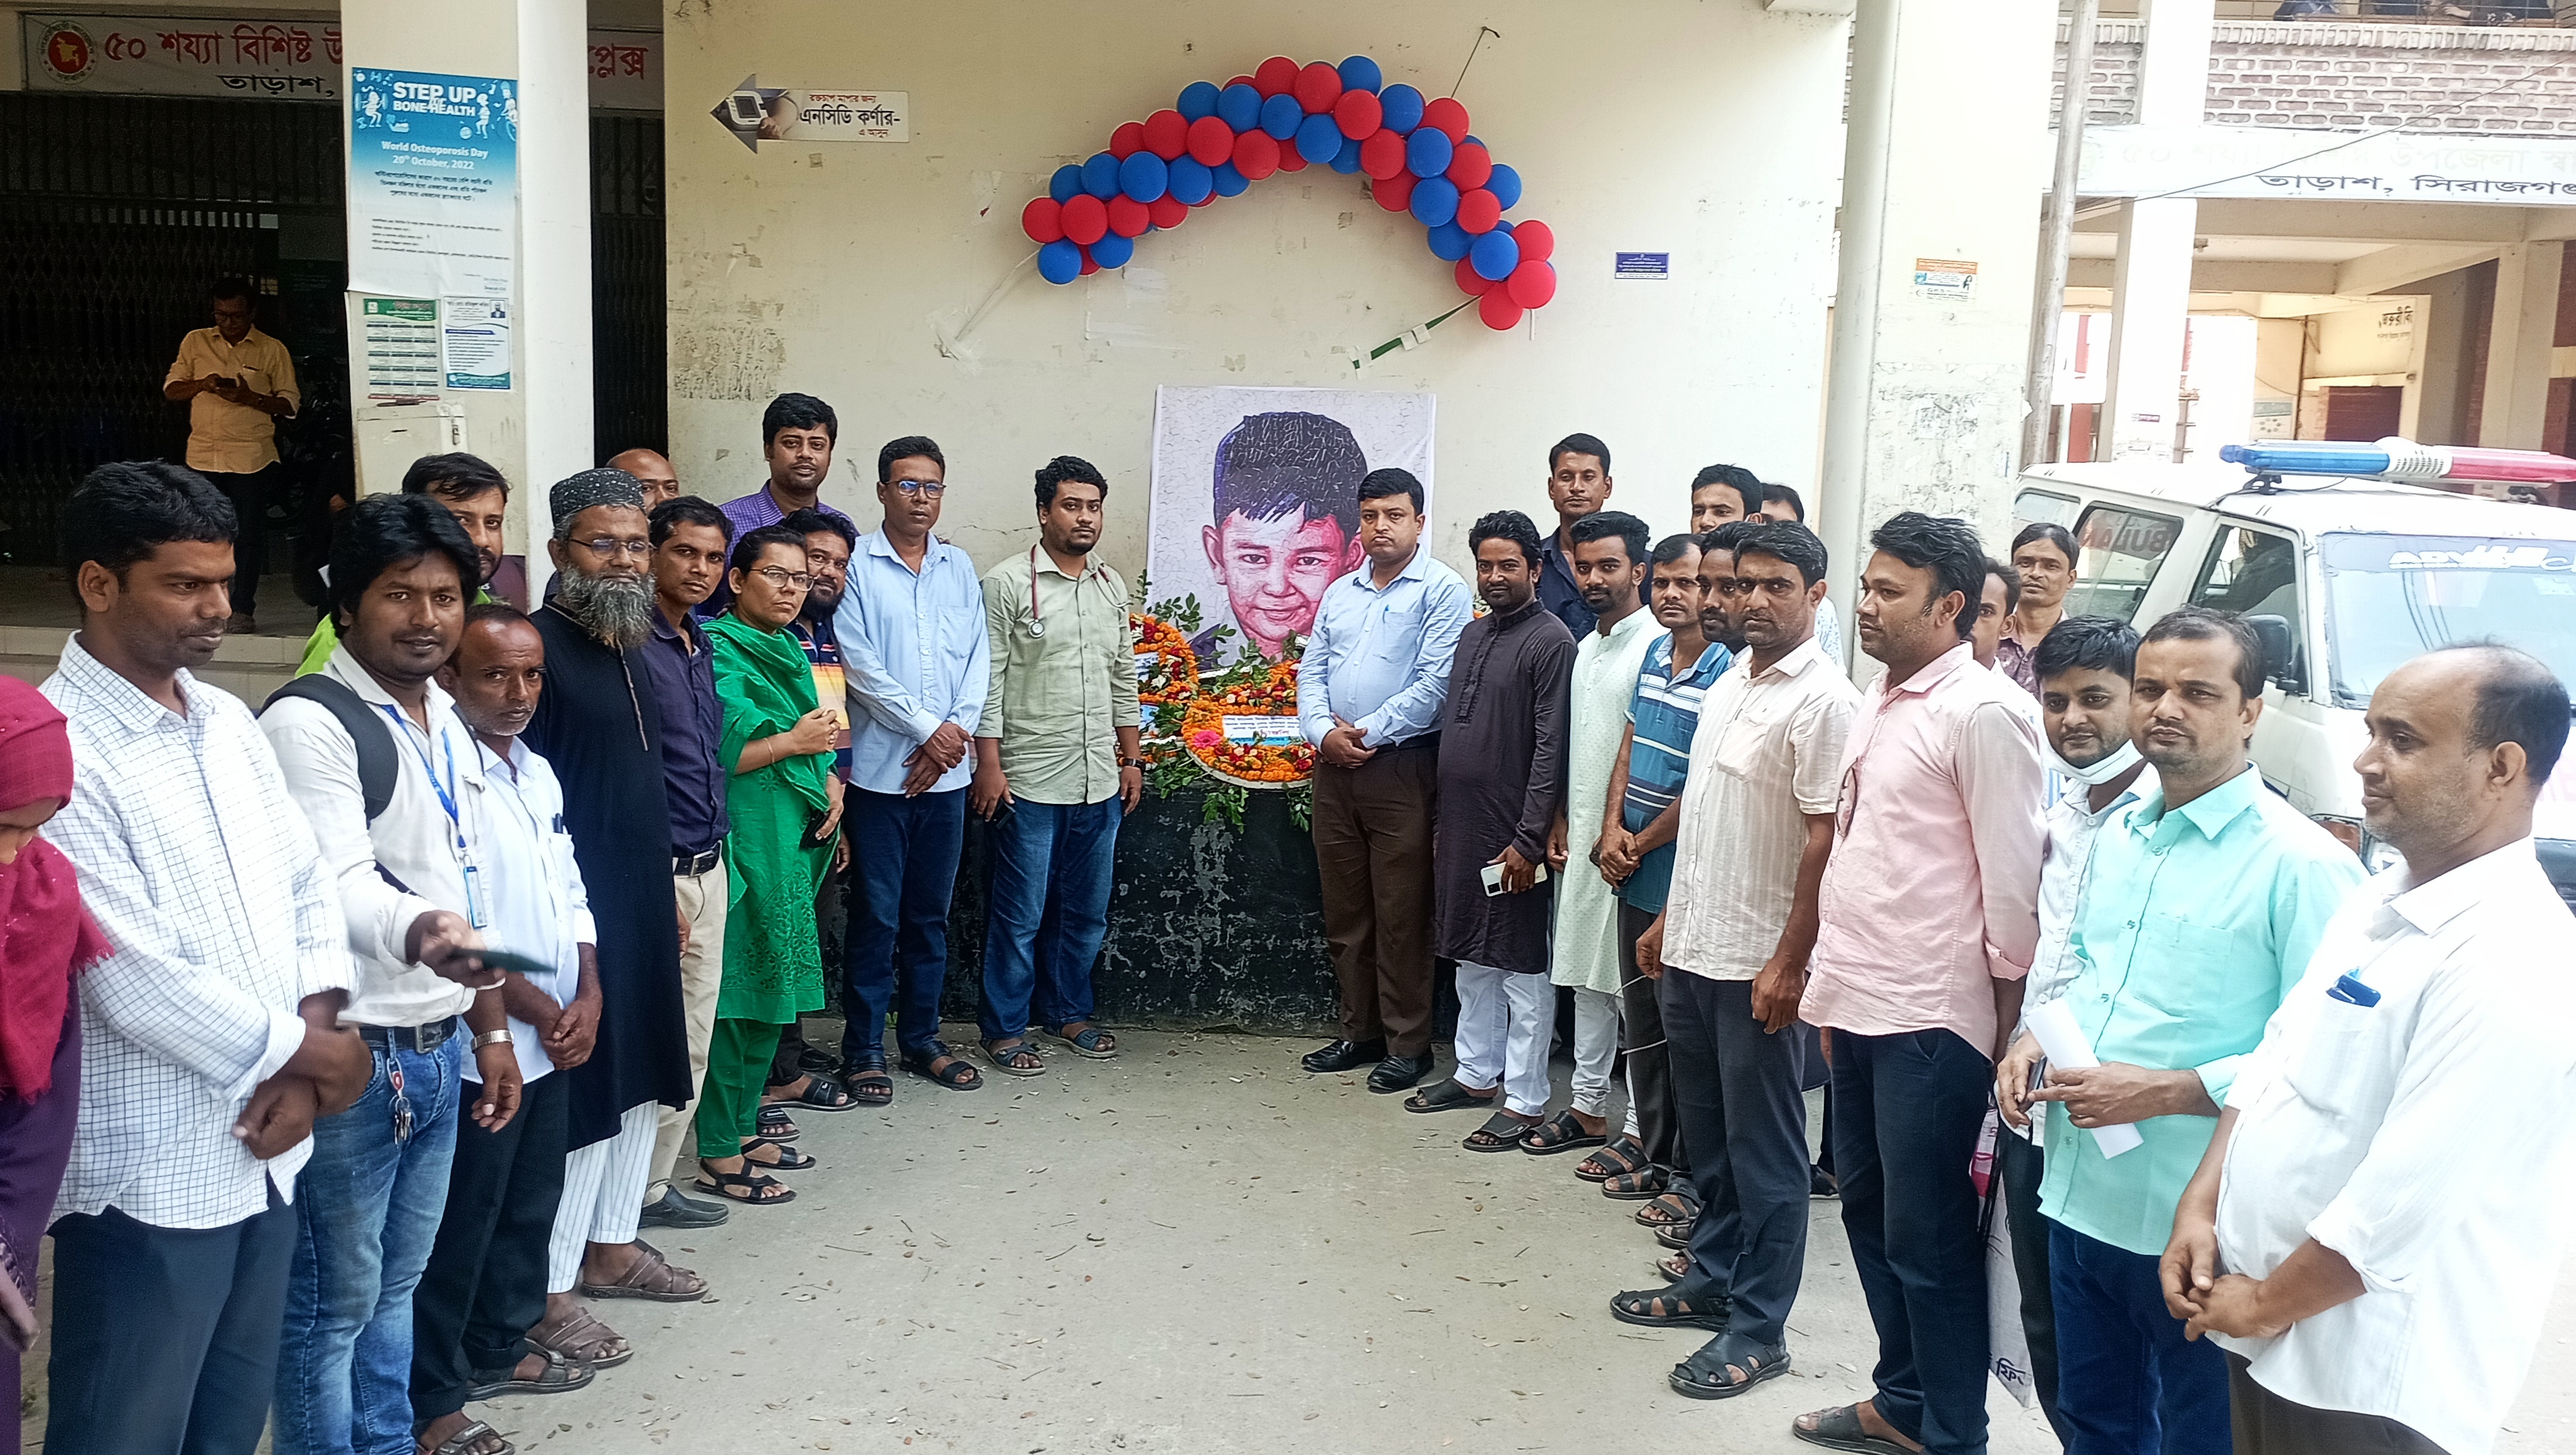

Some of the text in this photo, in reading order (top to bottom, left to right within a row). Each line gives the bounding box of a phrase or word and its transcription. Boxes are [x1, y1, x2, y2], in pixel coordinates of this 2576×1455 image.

[104, 32, 146, 61] ৫০
[156, 29, 224, 64] শয্যা
[231, 24, 313, 64] বিশিষ্ট
[217, 74, 335, 98] তাড়াশ,
[392, 81, 477, 104] STEP UP
[393, 100, 476, 117] BONE HEALTH
[800, 104, 853, 125] এনসিডি
[381, 140, 489, 159] World Osteoporosis Day
[412, 156, 450, 169] October,
[451, 160, 475, 170] 2022
[2255, 175, 2394, 196] তাড়াশ,
